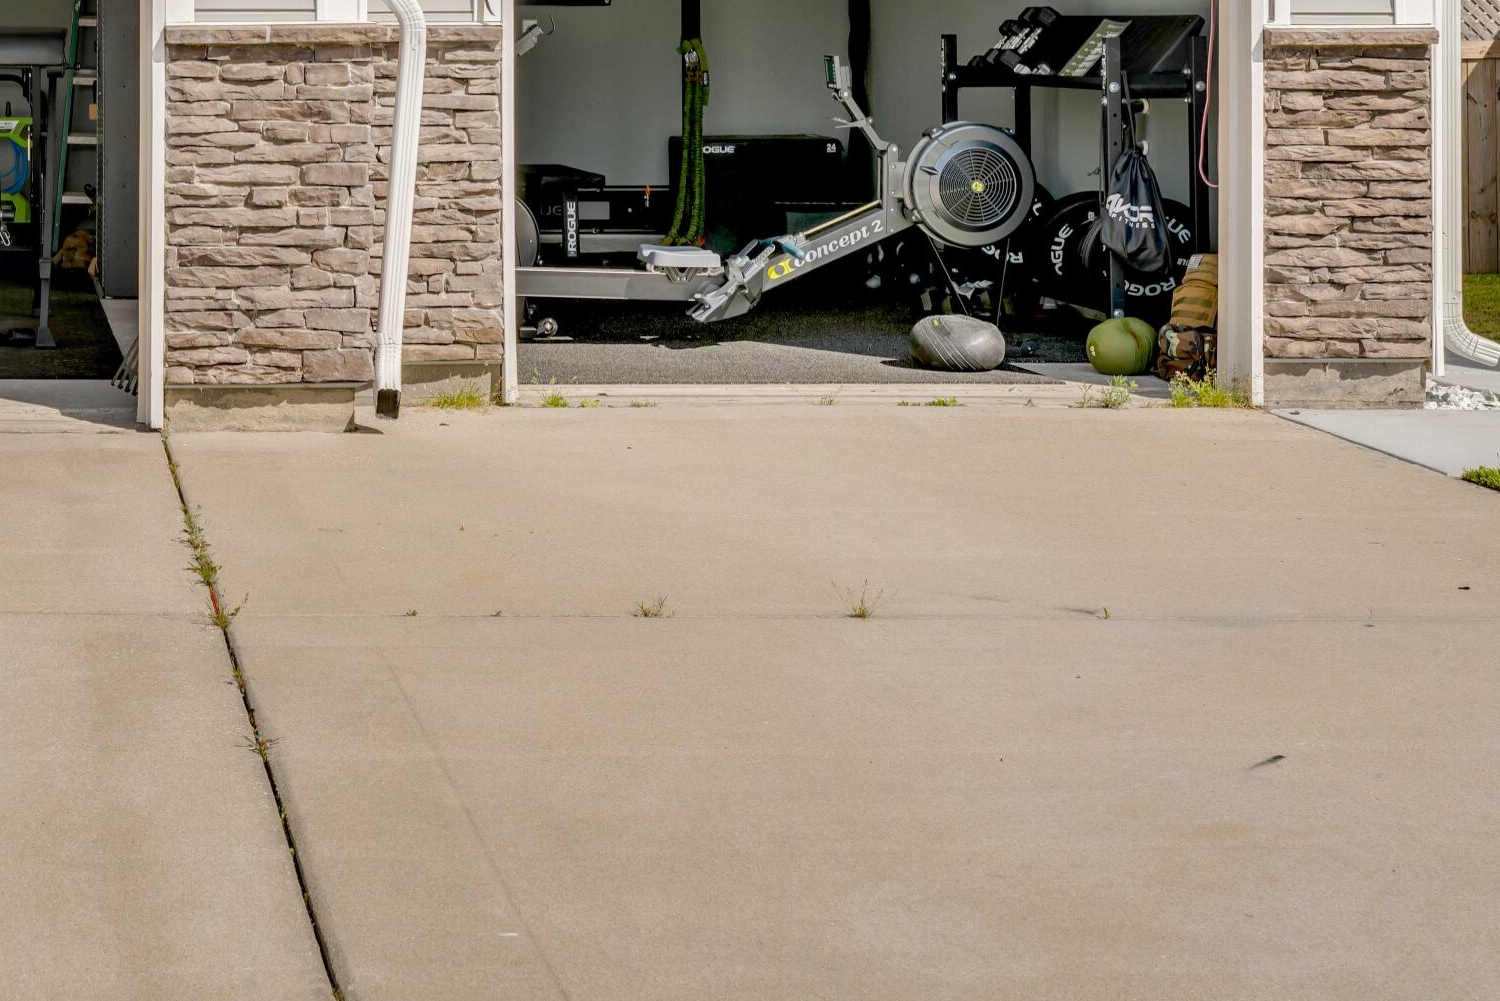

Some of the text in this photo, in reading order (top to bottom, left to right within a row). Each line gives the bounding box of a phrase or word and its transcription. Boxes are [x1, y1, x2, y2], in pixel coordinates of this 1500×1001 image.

[702, 145, 735, 154] OGUE
[826, 143, 836, 152] 24
[567, 201, 577, 252] ROGUE
[871, 220, 883, 233] 2
[1050, 223, 1073, 276] GUE
[1125, 277, 1176, 296] ROG
